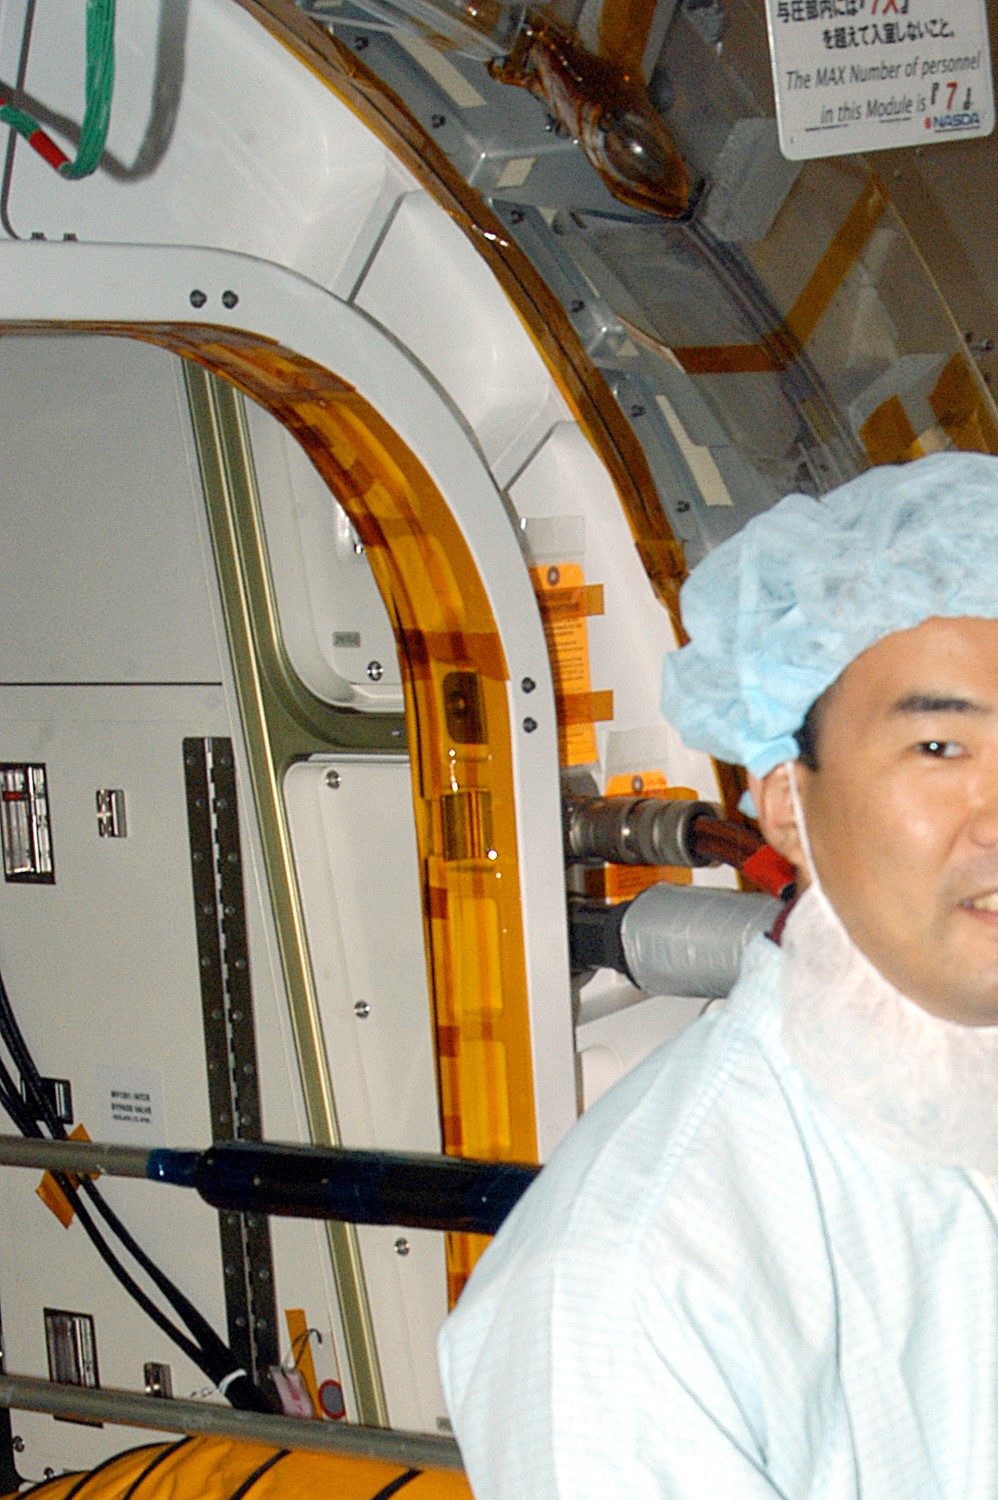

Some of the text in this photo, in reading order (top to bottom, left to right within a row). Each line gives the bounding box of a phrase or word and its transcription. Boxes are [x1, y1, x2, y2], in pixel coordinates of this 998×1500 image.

[822, 18, 955, 49] を超えて入室しないこと。
[786, 51, 981, 91] The MAX Number of personnel
[820, 105, 834, 124] in
[837, 99, 862, 122] this
[865, 94, 914, 119] Module
[916, 95, 927, 113] is
[933, 112, 981, 128] NASDA
